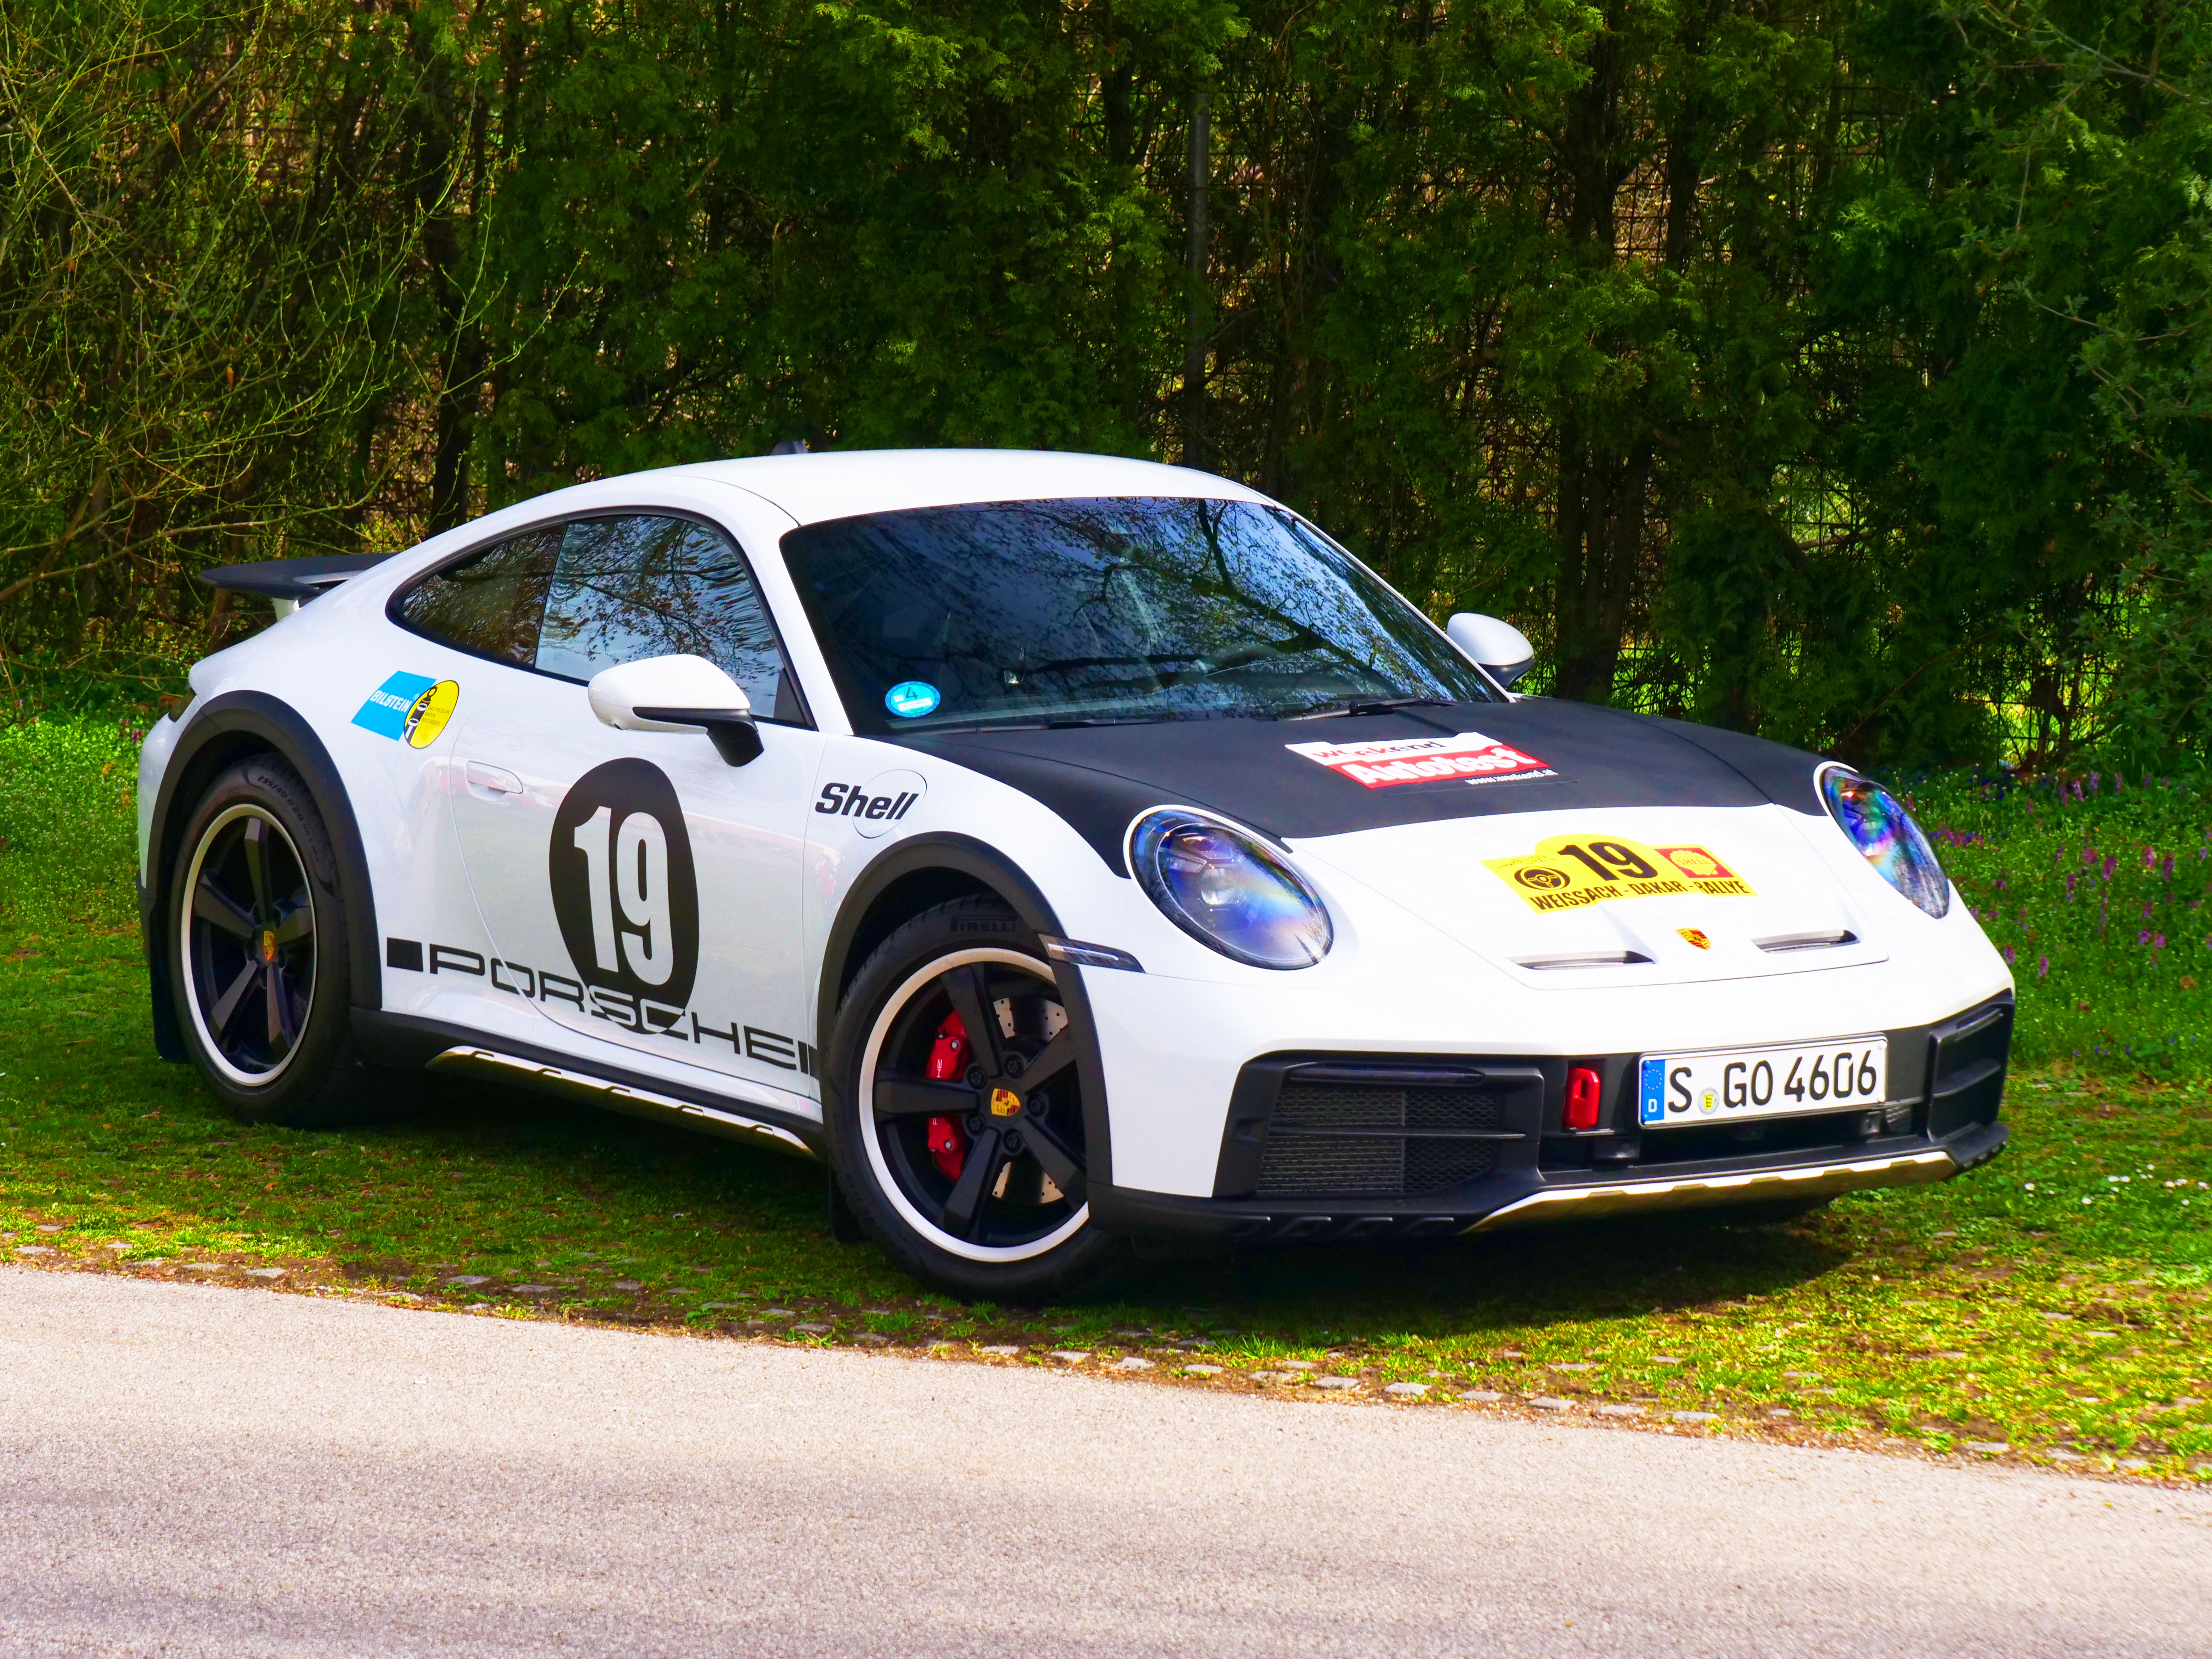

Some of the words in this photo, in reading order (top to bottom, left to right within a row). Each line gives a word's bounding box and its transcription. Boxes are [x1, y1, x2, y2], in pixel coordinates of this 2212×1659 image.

[369, 690, 413, 713] BILSTEIN
[905, 686, 918, 699] 4
[1342, 747, 1537, 784] Autotest
[1464, 768, 1559, 785] www.weekend.at
[257, 775, 288, 797] 295/40
[815, 782, 919, 820] Shell
[1556, 842, 1658, 881] 19
[574, 805, 674, 985] 19
[1529, 885, 1623, 911] WEISSACH
[1627, 881, 1688, 894] DAKAR
[1693, 881, 1749, 894] RALLYE
[950, 915, 1018, 932] PIRELLI
[429, 943, 797, 1070] PORSCHE
[1668, 1066, 1693, 1113] S
[1724, 1059, 1773, 1108] GO
[1784, 1050, 1877, 1102] 4606
[1648, 1098, 1658, 1113] D
